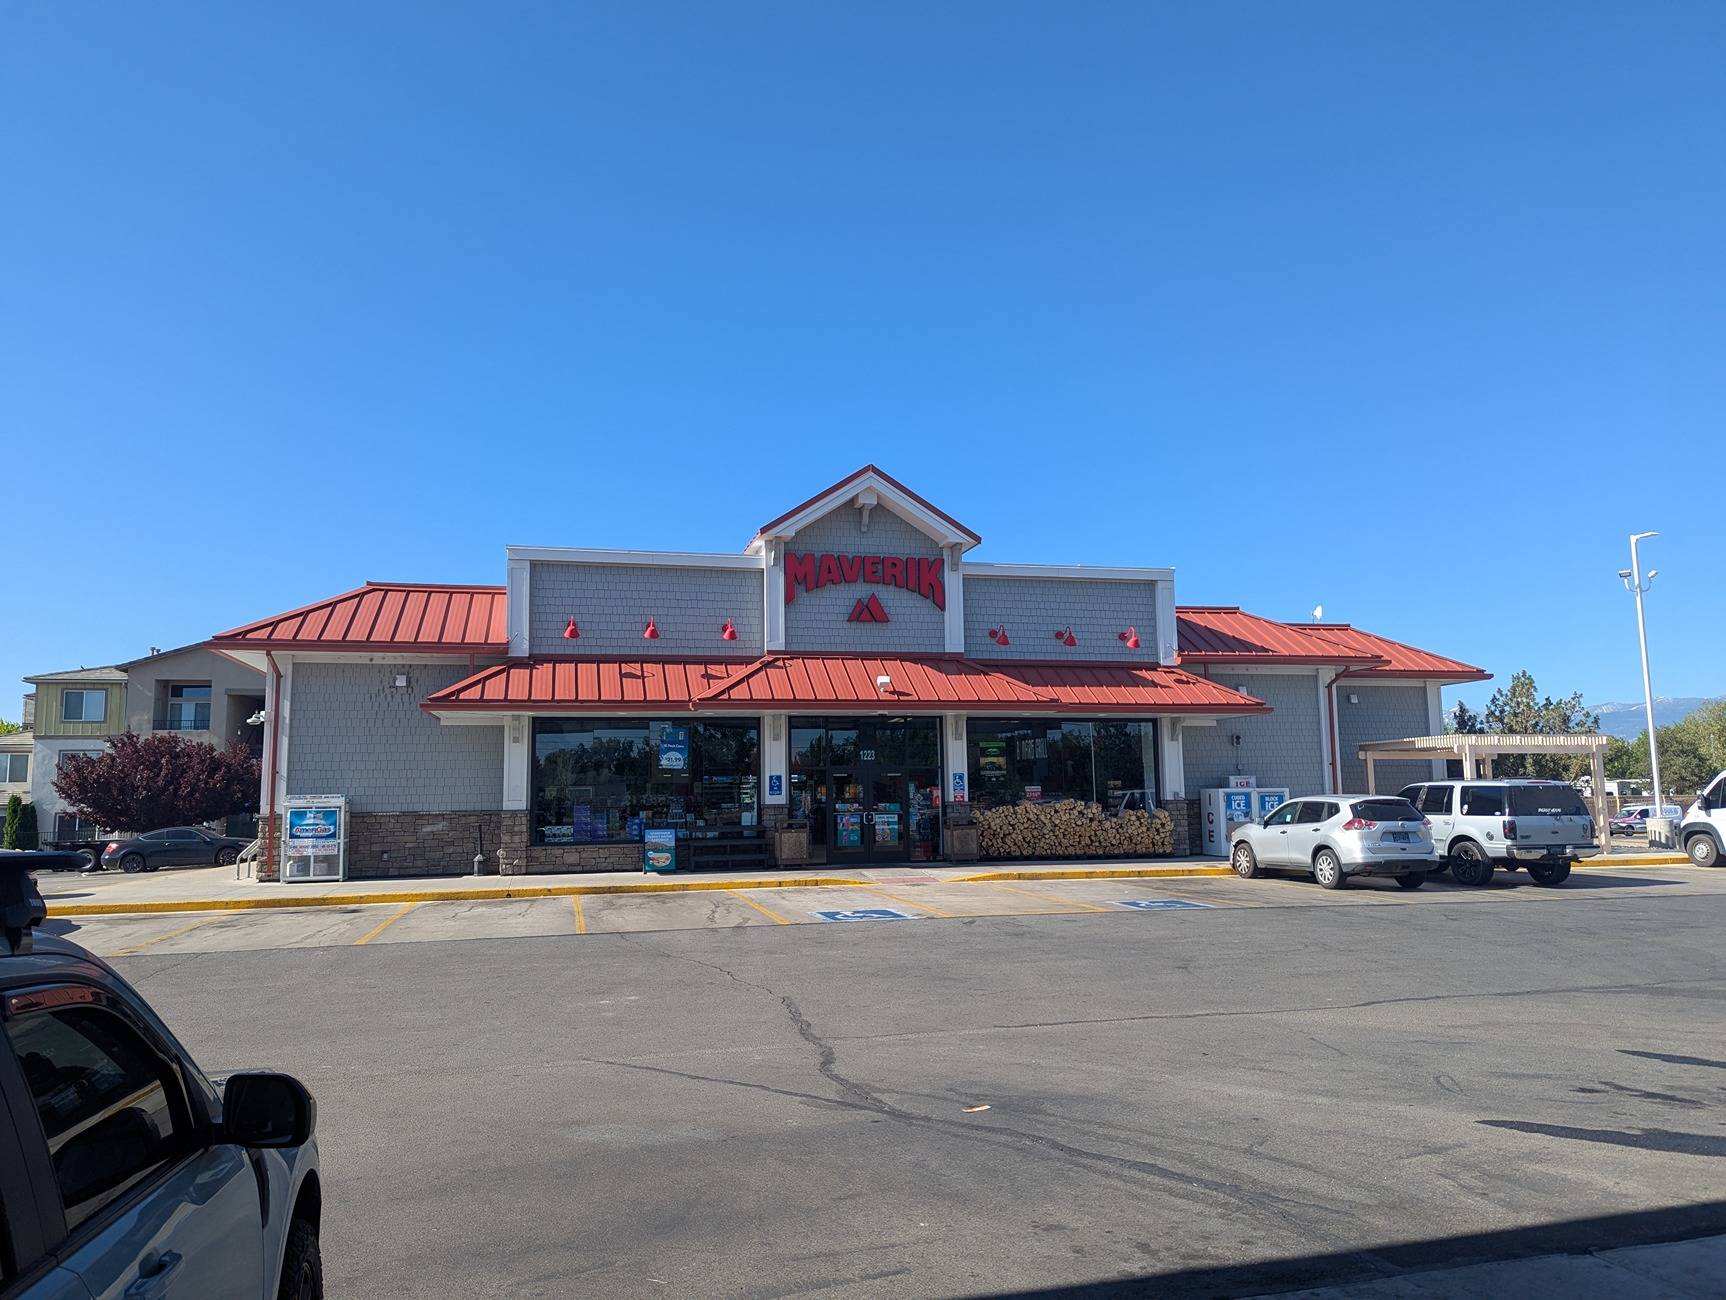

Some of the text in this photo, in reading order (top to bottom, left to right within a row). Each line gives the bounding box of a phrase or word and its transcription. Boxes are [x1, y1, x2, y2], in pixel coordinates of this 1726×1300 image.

[784, 552, 945, 611] MAVERIK
[859, 750, 875, 760] 1223
[1231, 801, 1246, 810] ICE
[1265, 802, 1279, 811] ICE
[295, 826, 332, 834] AmeriGas
